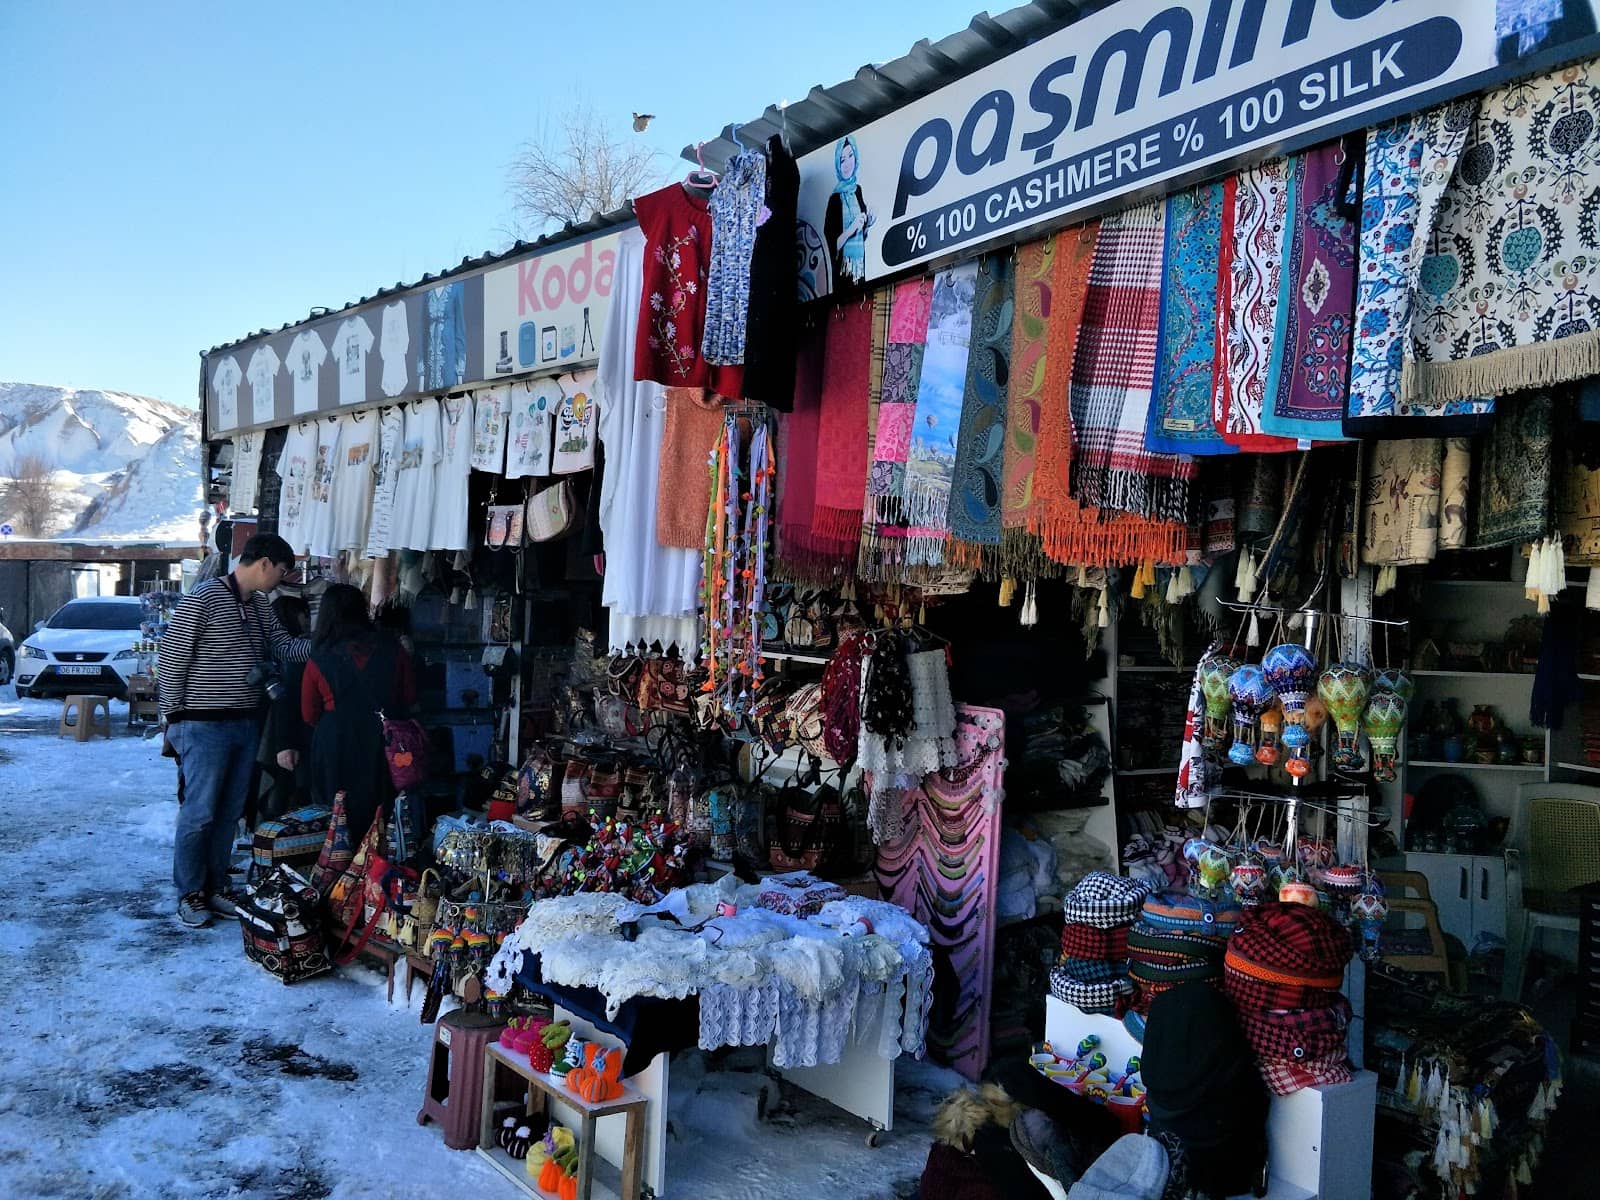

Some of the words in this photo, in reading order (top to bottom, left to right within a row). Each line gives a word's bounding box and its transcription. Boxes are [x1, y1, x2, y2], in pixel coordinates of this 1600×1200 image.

[892, 0, 1398, 220] paşmin
[906, 221, 927, 254] %
[935, 203, 977, 241] 100
[984, 132, 1162, 224] CASHMERE
[1173, 117, 1205, 157] %
[1218, 87, 1285, 140] 100
[1299, 39, 1405, 112] SILK
